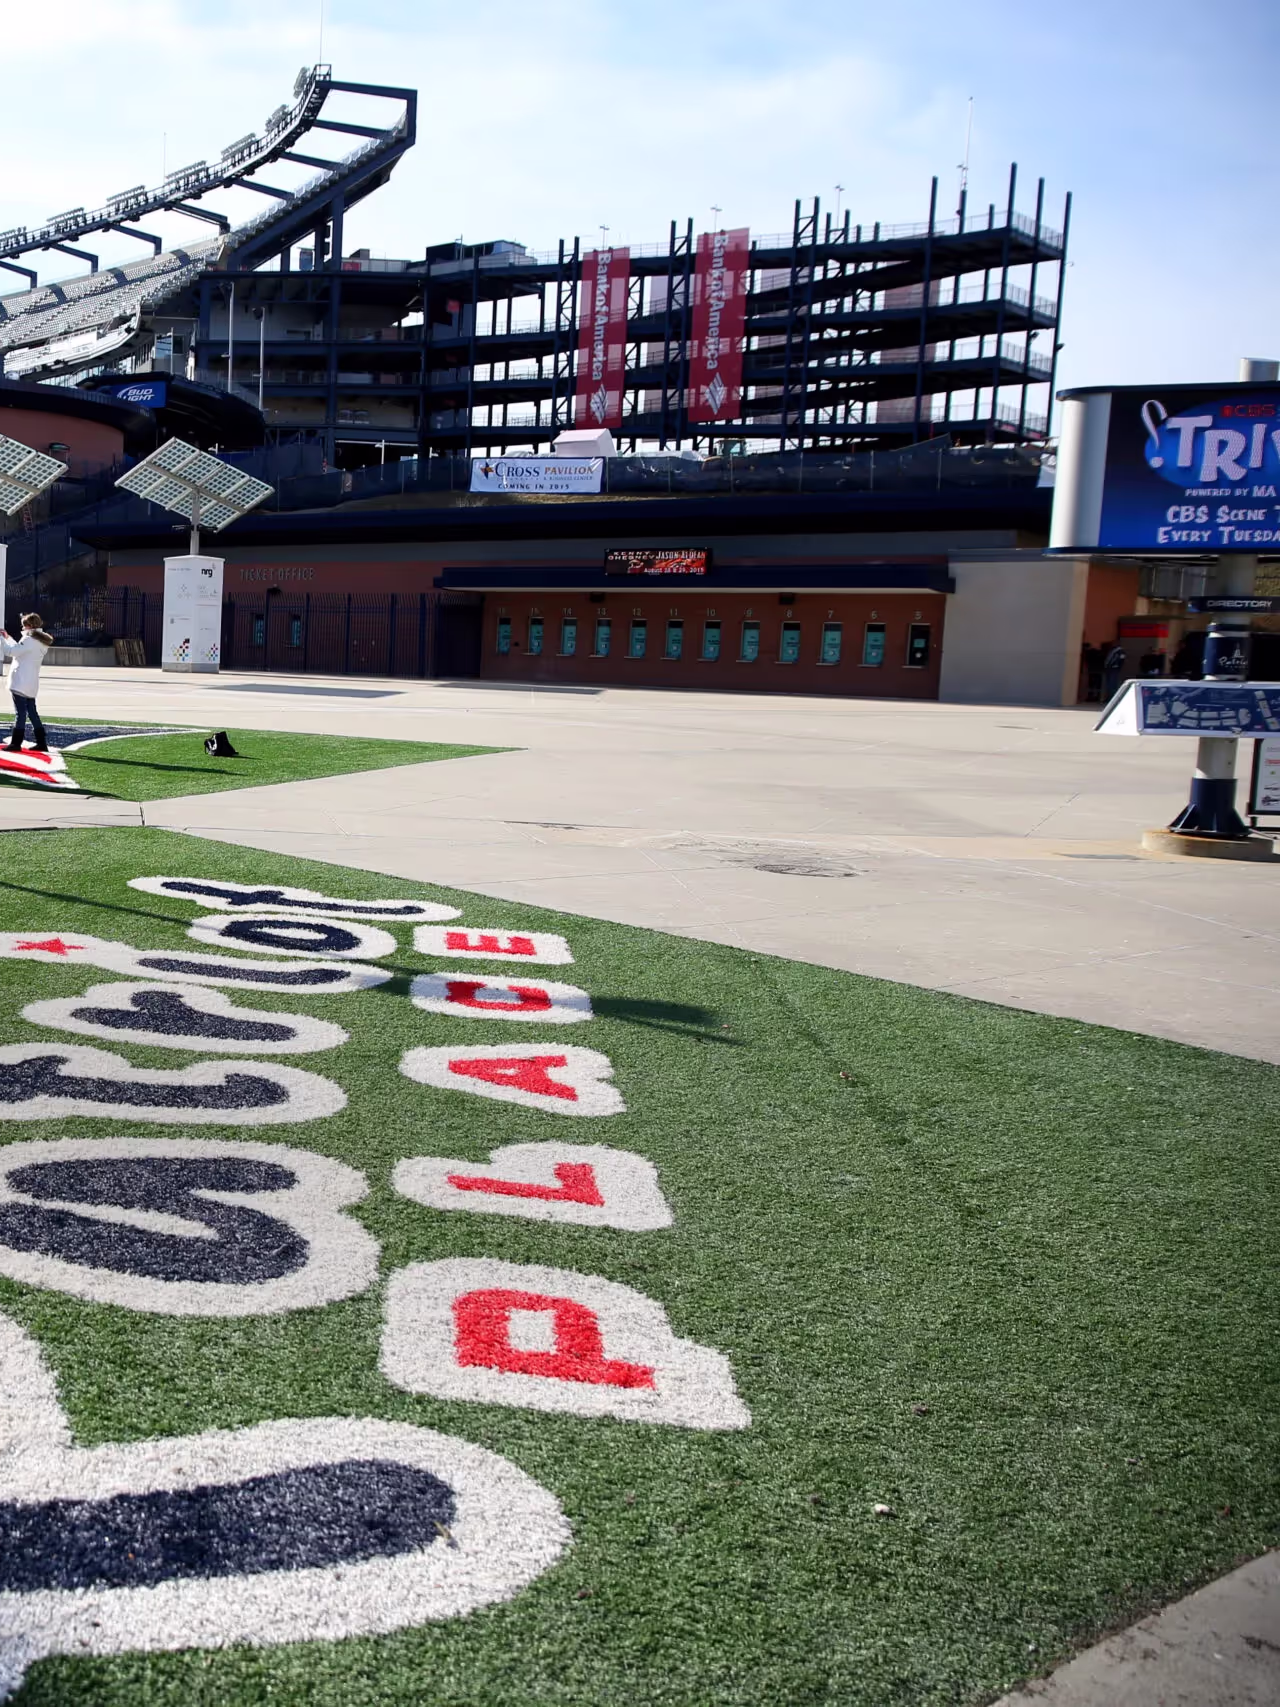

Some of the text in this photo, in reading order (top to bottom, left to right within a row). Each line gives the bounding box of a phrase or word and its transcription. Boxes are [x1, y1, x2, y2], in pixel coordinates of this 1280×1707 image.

[127, 388, 153, 396] BUD
[495, 462, 594, 477] CROSS PAVILION
[1185, 488, 1232, 497] POWERED
[1234, 488, 1250, 497] BY
[1166, 505, 1209, 523] CBS
[656, 551, 679, 560] JASON
[201, 568, 213, 578] nrg
[240, 567, 315, 581] TICKET OFFICE
[1207, 599, 1272, 608] DIRECTORY
[425, 926, 690, 1402] PLACE
